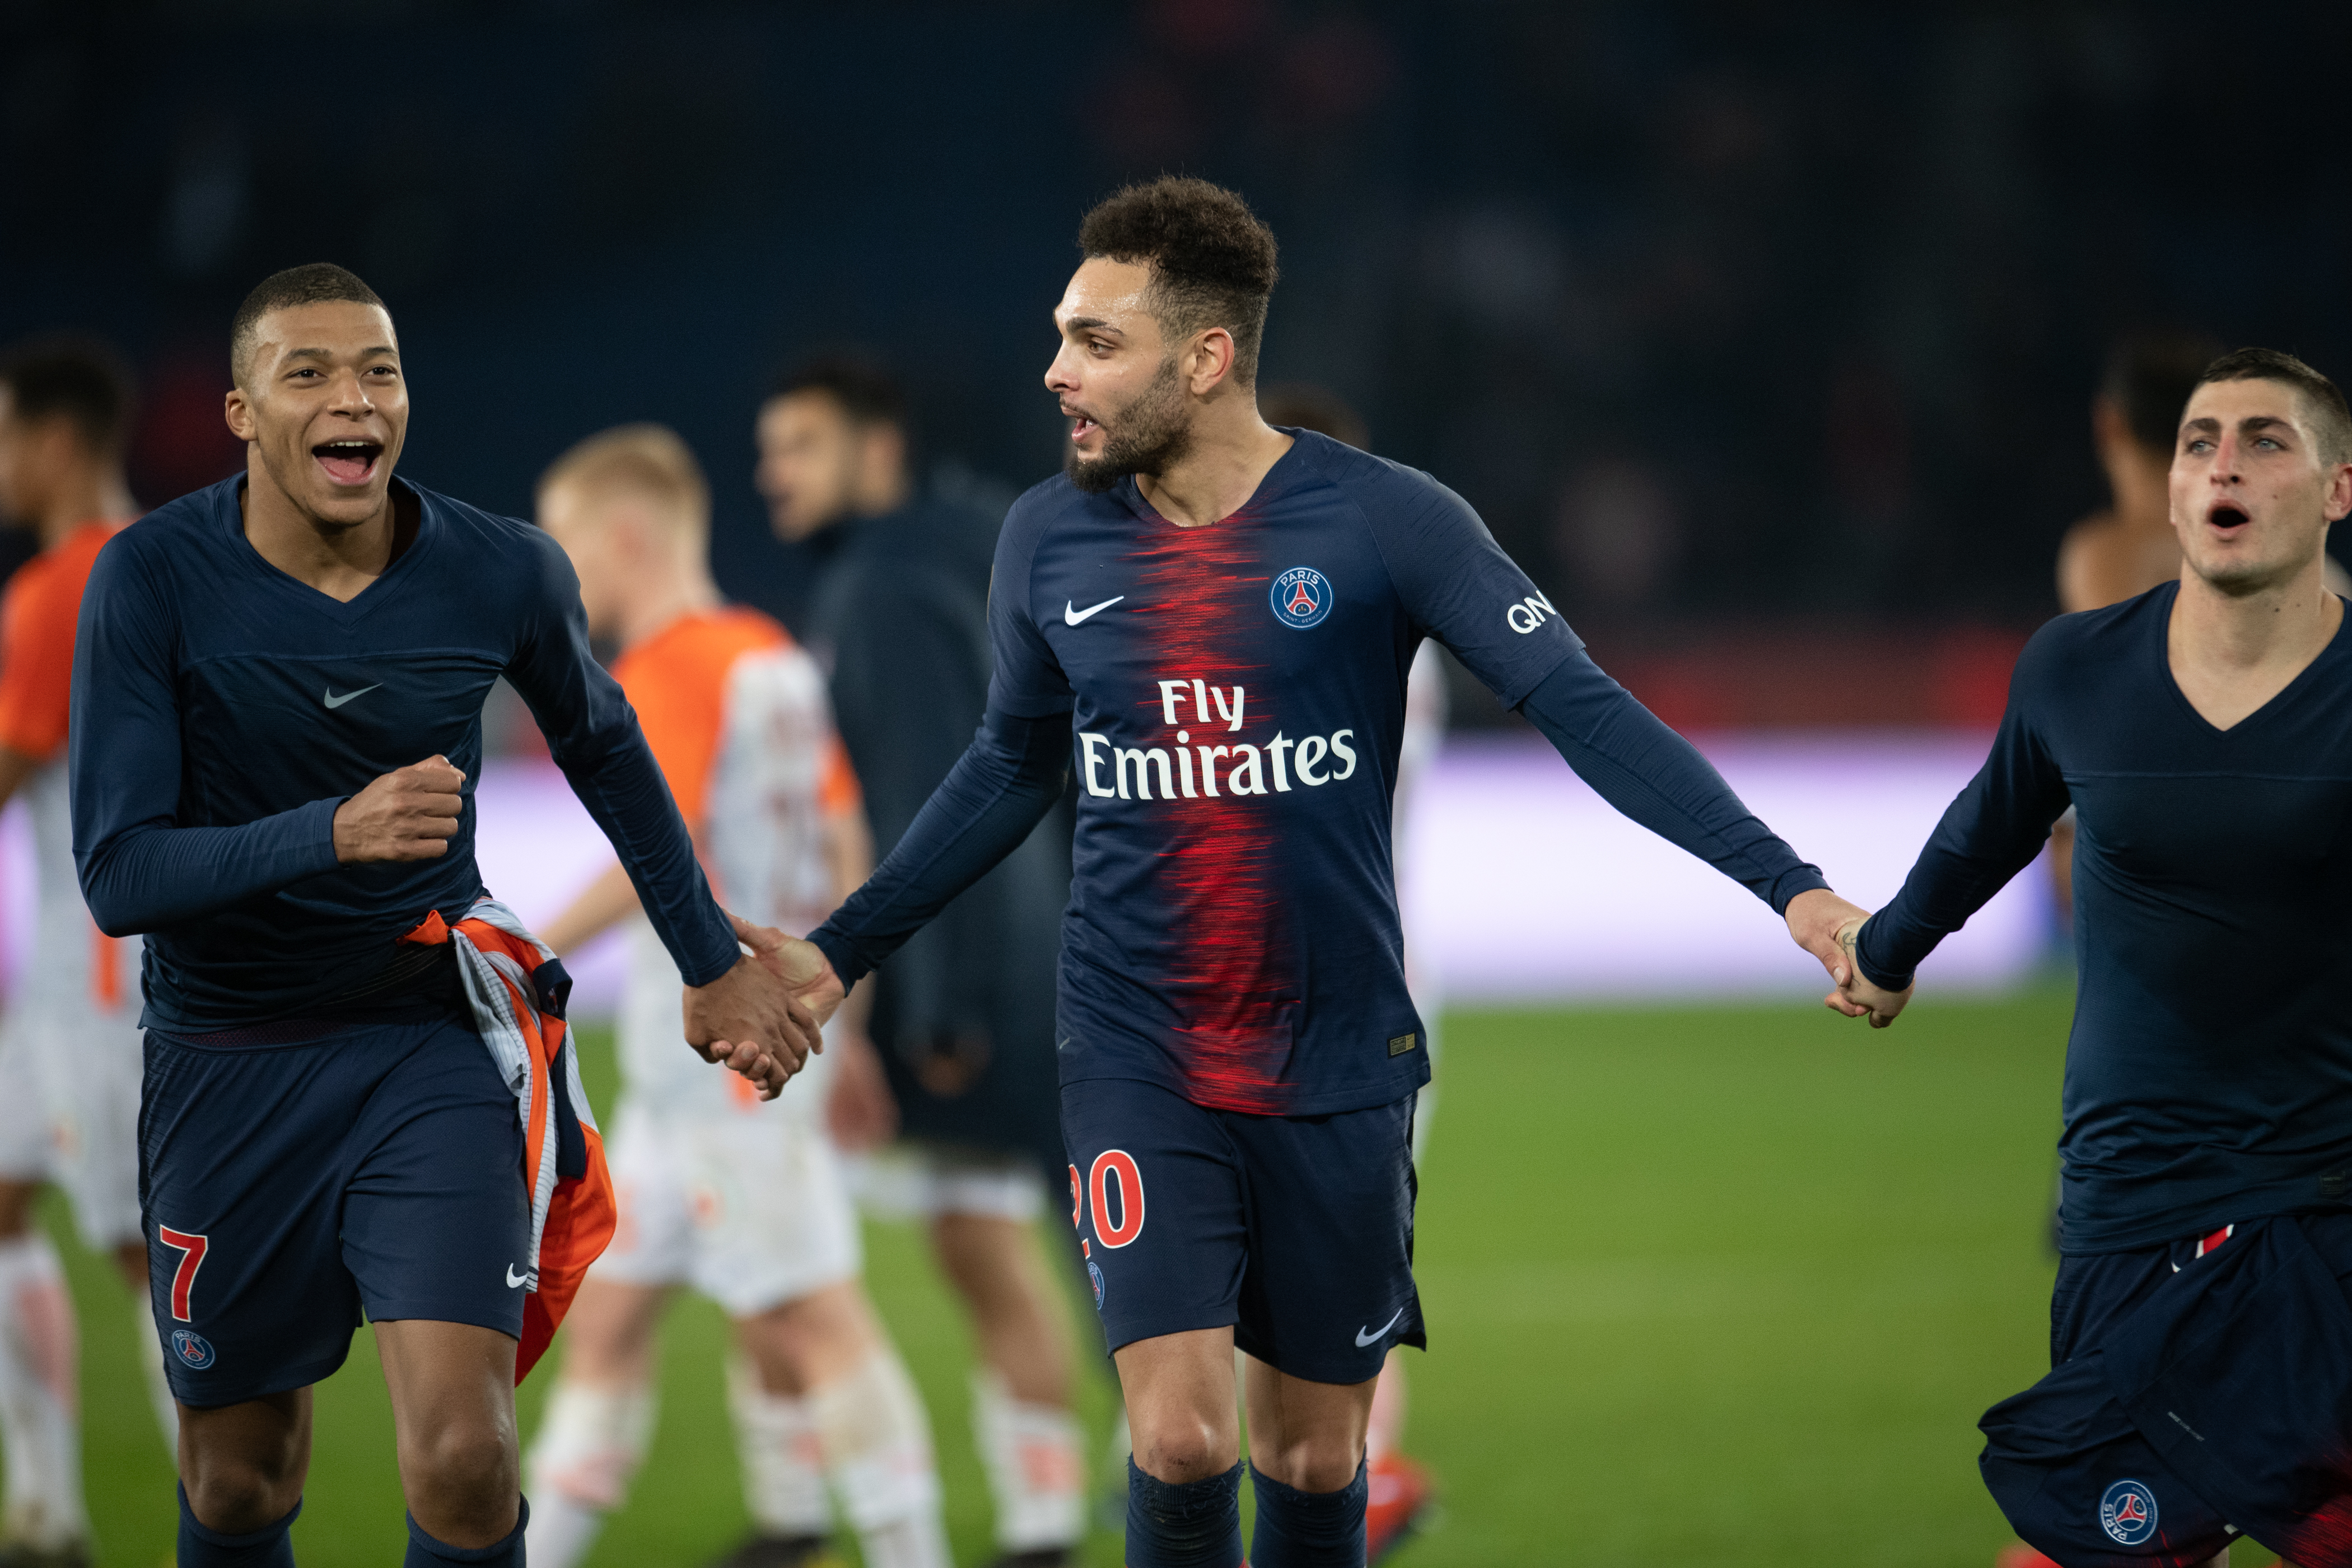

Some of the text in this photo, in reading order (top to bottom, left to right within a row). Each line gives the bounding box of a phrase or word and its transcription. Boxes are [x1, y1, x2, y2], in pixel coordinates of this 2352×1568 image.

[1280, 571, 1320, 586] PARIS
[1158, 679, 1244, 731] Fly
[1078, 729, 1357, 800] Emirates
[160, 1224, 208, 1323] 7
[175, 1331, 201, 1343] PARIS
[2104, 1504, 2128, 1541] PARIS
